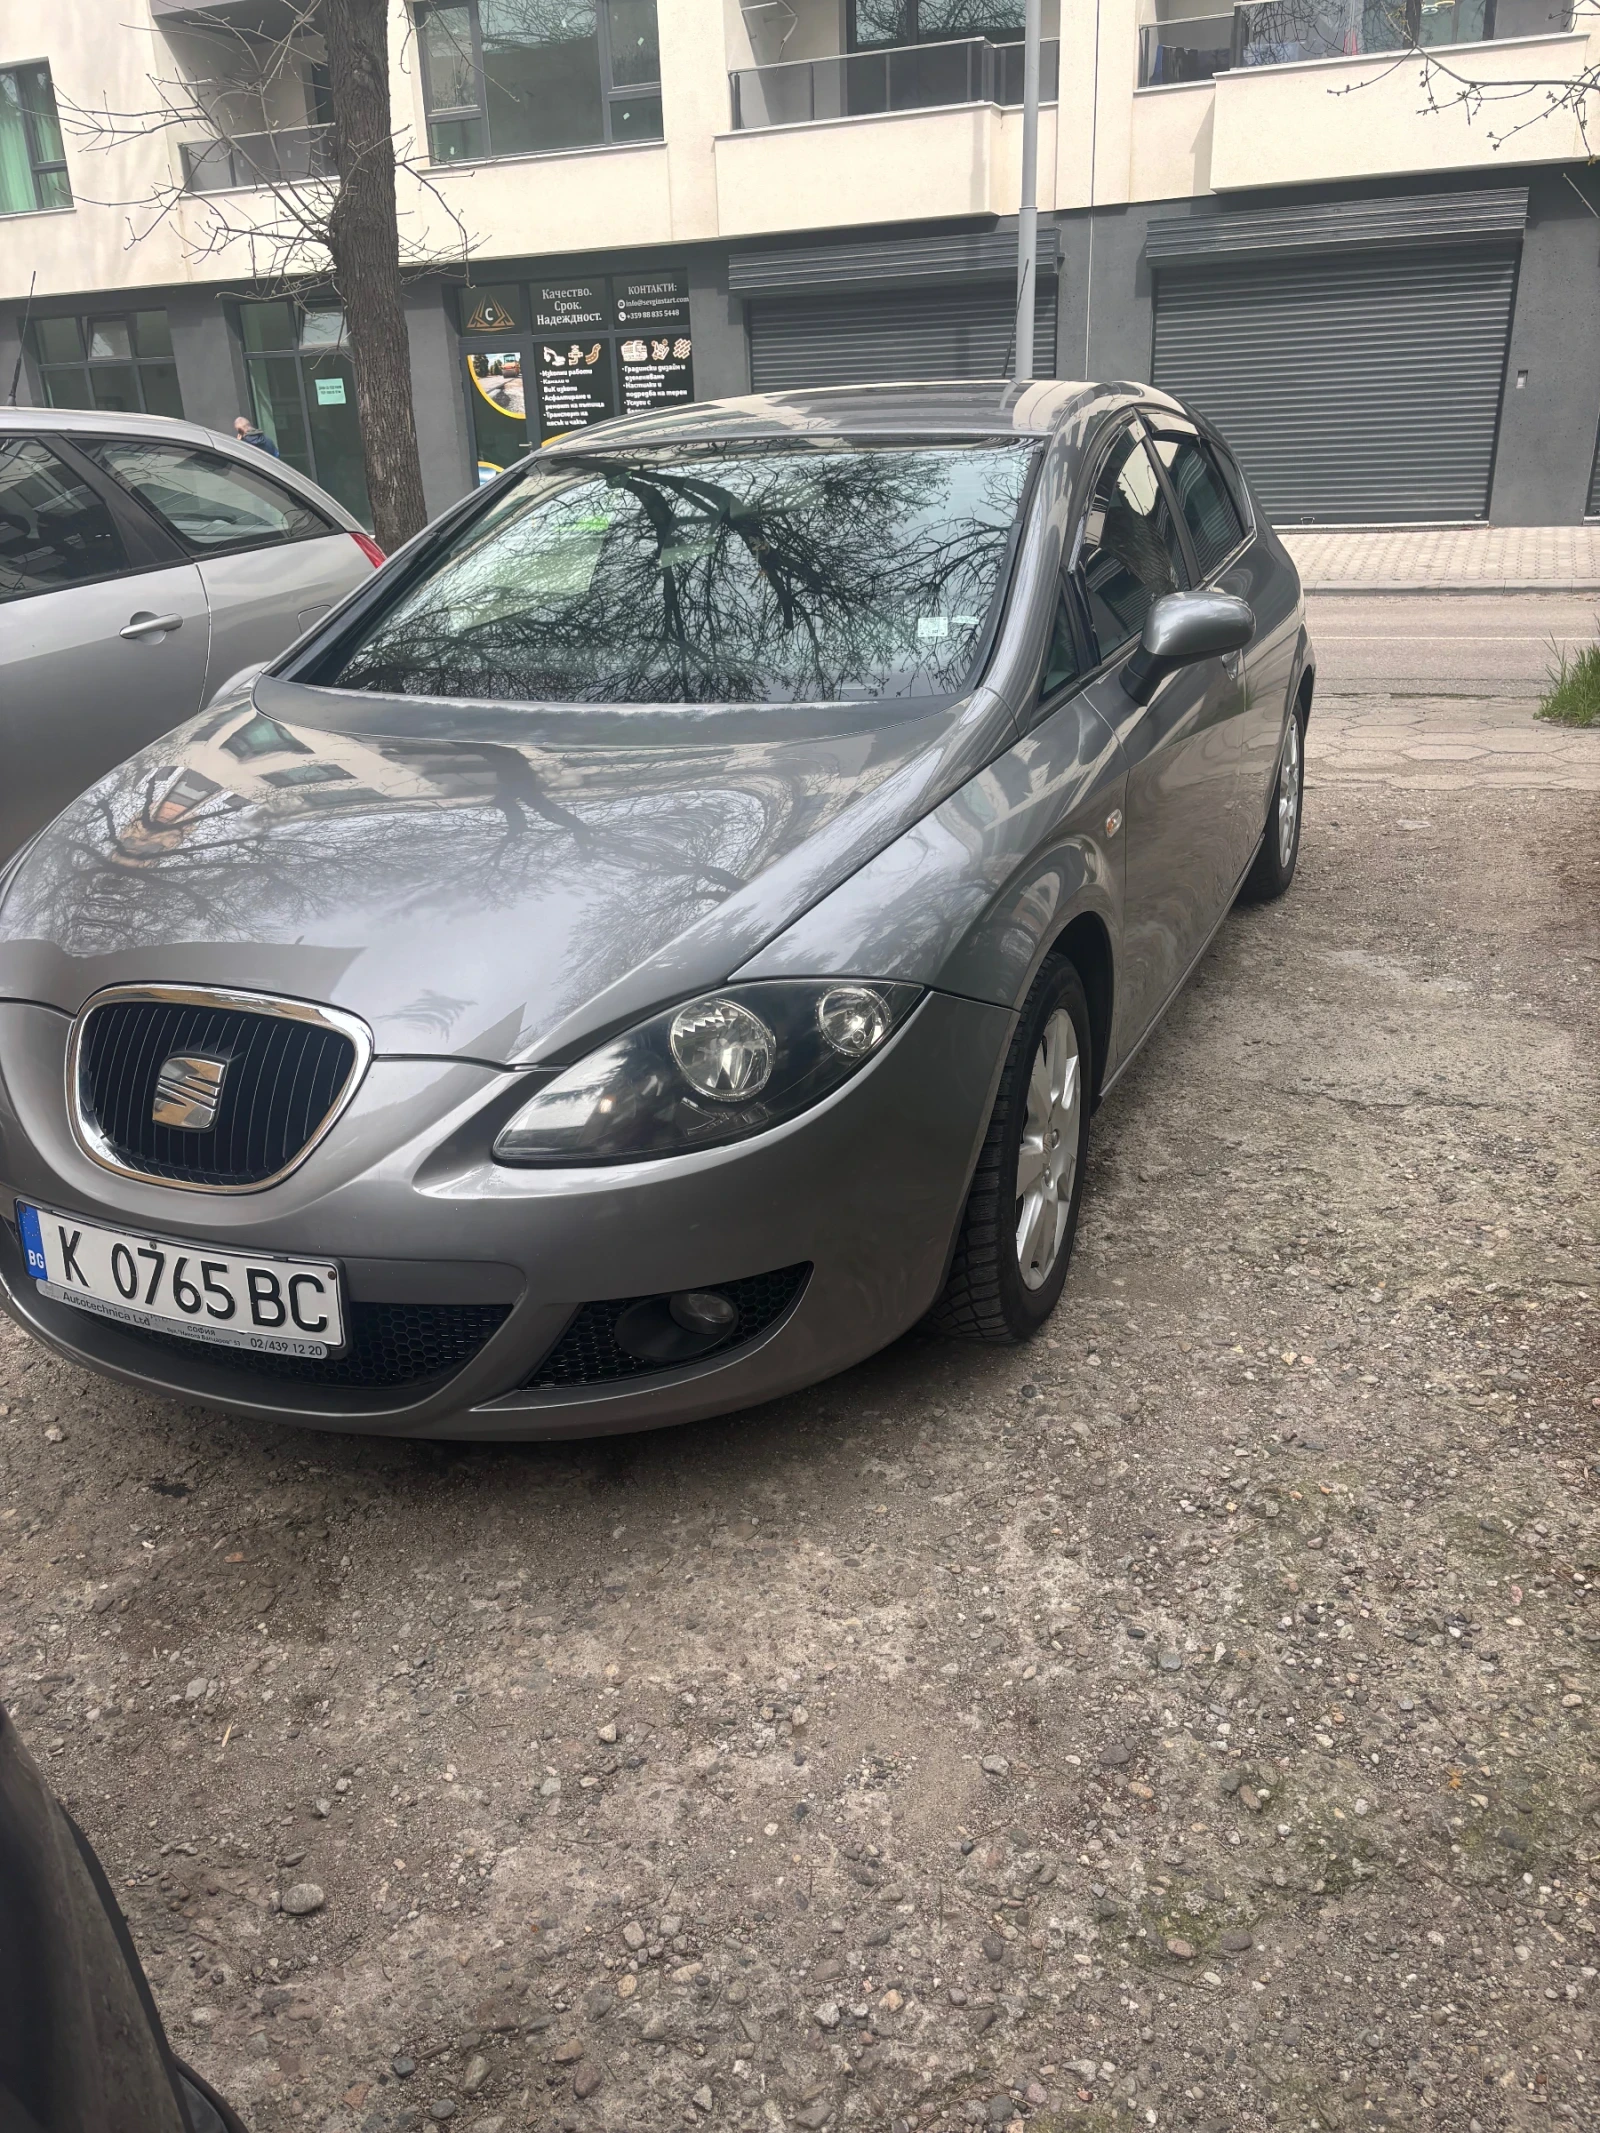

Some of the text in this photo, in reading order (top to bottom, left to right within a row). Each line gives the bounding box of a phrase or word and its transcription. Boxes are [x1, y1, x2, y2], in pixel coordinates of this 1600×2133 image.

[542, 287, 593, 300] Качество.
[627, 282, 678, 295] КОНТАКТИ:
[554, 300, 582, 313] Срок.
[536, 312, 602, 326] Надеждност.
[626, 311, 642, 320] +359
[642, 311, 651, 319] 88
[27, 1249, 46, 1270] BG
[57, 1225, 91, 1289] K
[62, 1291, 131, 1321] Autotechnica
[133, 1314, 151, 1327] Ltd
[186, 1325, 217, 1337] СОФИЯ
[249, 1337, 323, 1357] 02/439 12 20
